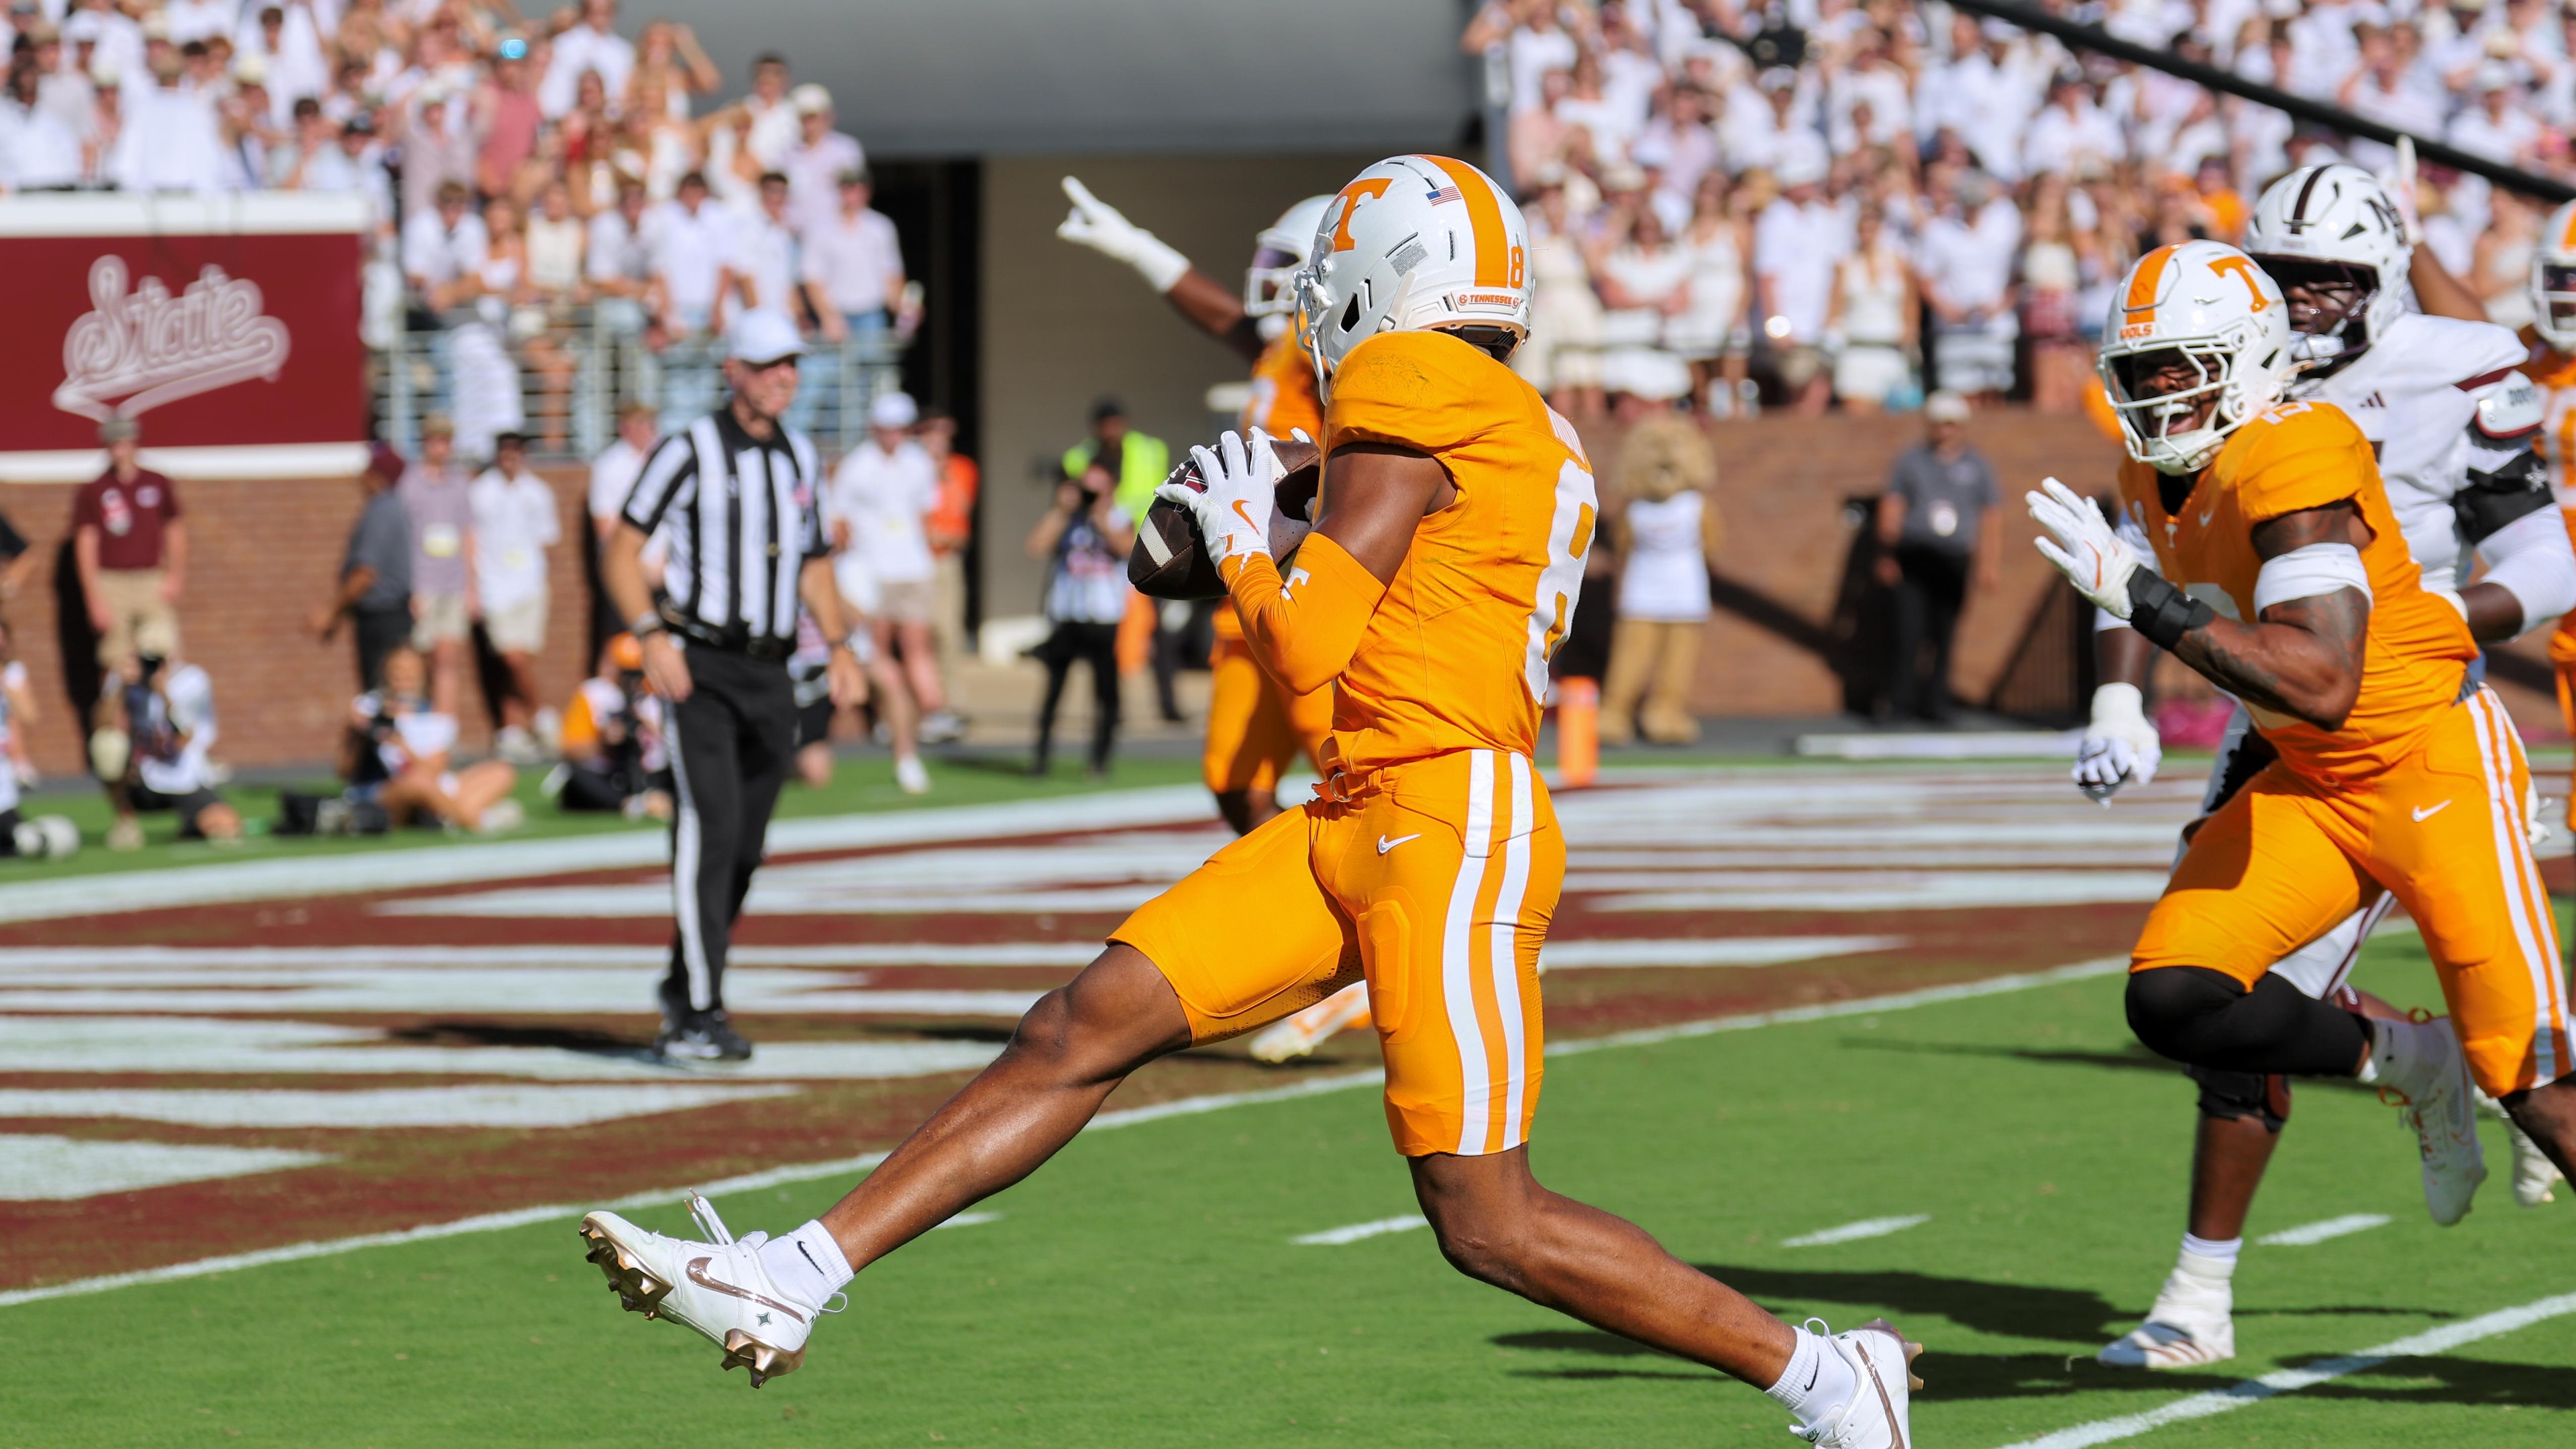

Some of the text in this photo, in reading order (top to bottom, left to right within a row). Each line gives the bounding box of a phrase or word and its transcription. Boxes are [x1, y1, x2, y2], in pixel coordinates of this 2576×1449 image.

[1331, 178, 1393, 252] T
[1469, 294, 1513, 305] TENNESSEE
[1509, 246, 1524, 289] 8
[2206, 256, 2271, 313] T
[51, 254, 291, 424] State
[1525, 458, 1599, 706] 8
